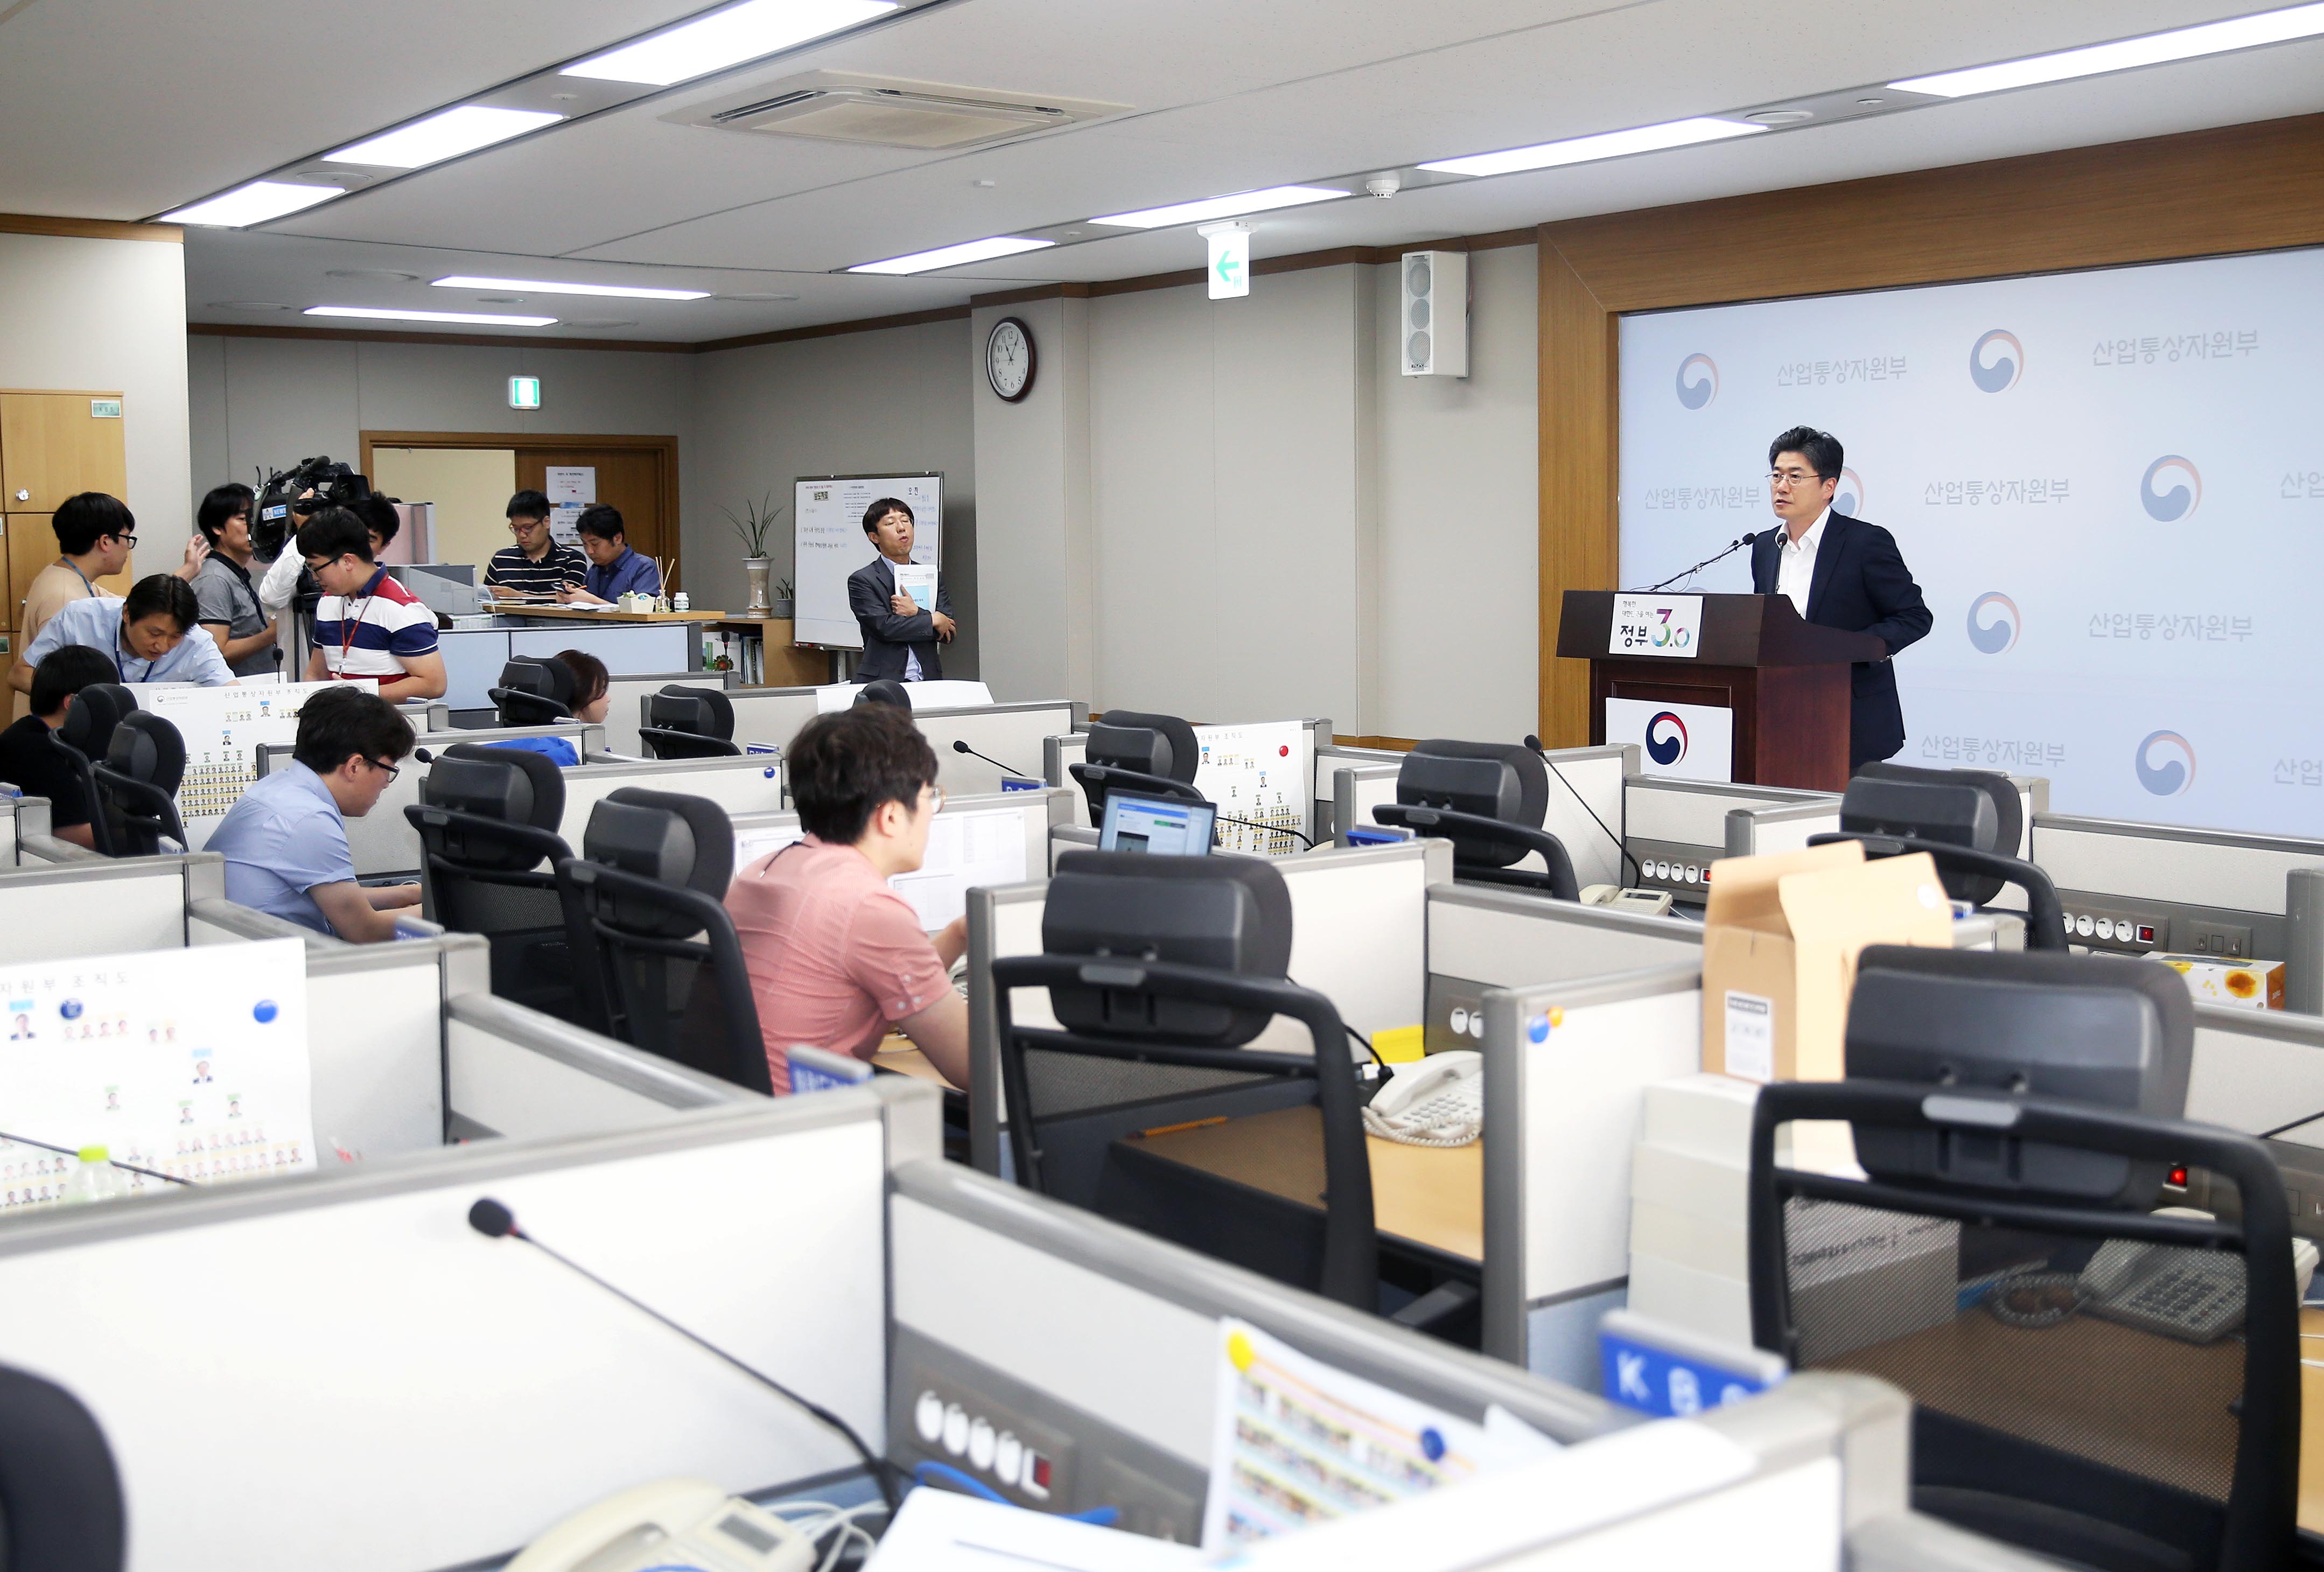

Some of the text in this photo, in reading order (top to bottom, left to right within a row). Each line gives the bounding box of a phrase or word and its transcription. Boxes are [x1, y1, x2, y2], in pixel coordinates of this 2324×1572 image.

[2092, 329, 2259, 367] 산업통상자원부
[1777, 355, 1907, 387] 산업통상자원부
[1645, 486, 1761, 511] 산업통상자원부
[1924, 478, 2070, 506] 산업통상자원부
[1620, 609, 1690, 648] 정부 3.0
[2089, 613, 2253, 642] 산업통상자원부
[1921, 735, 2066, 767] 산업통상자원부
[2273, 758, 2324, 787] 산업
